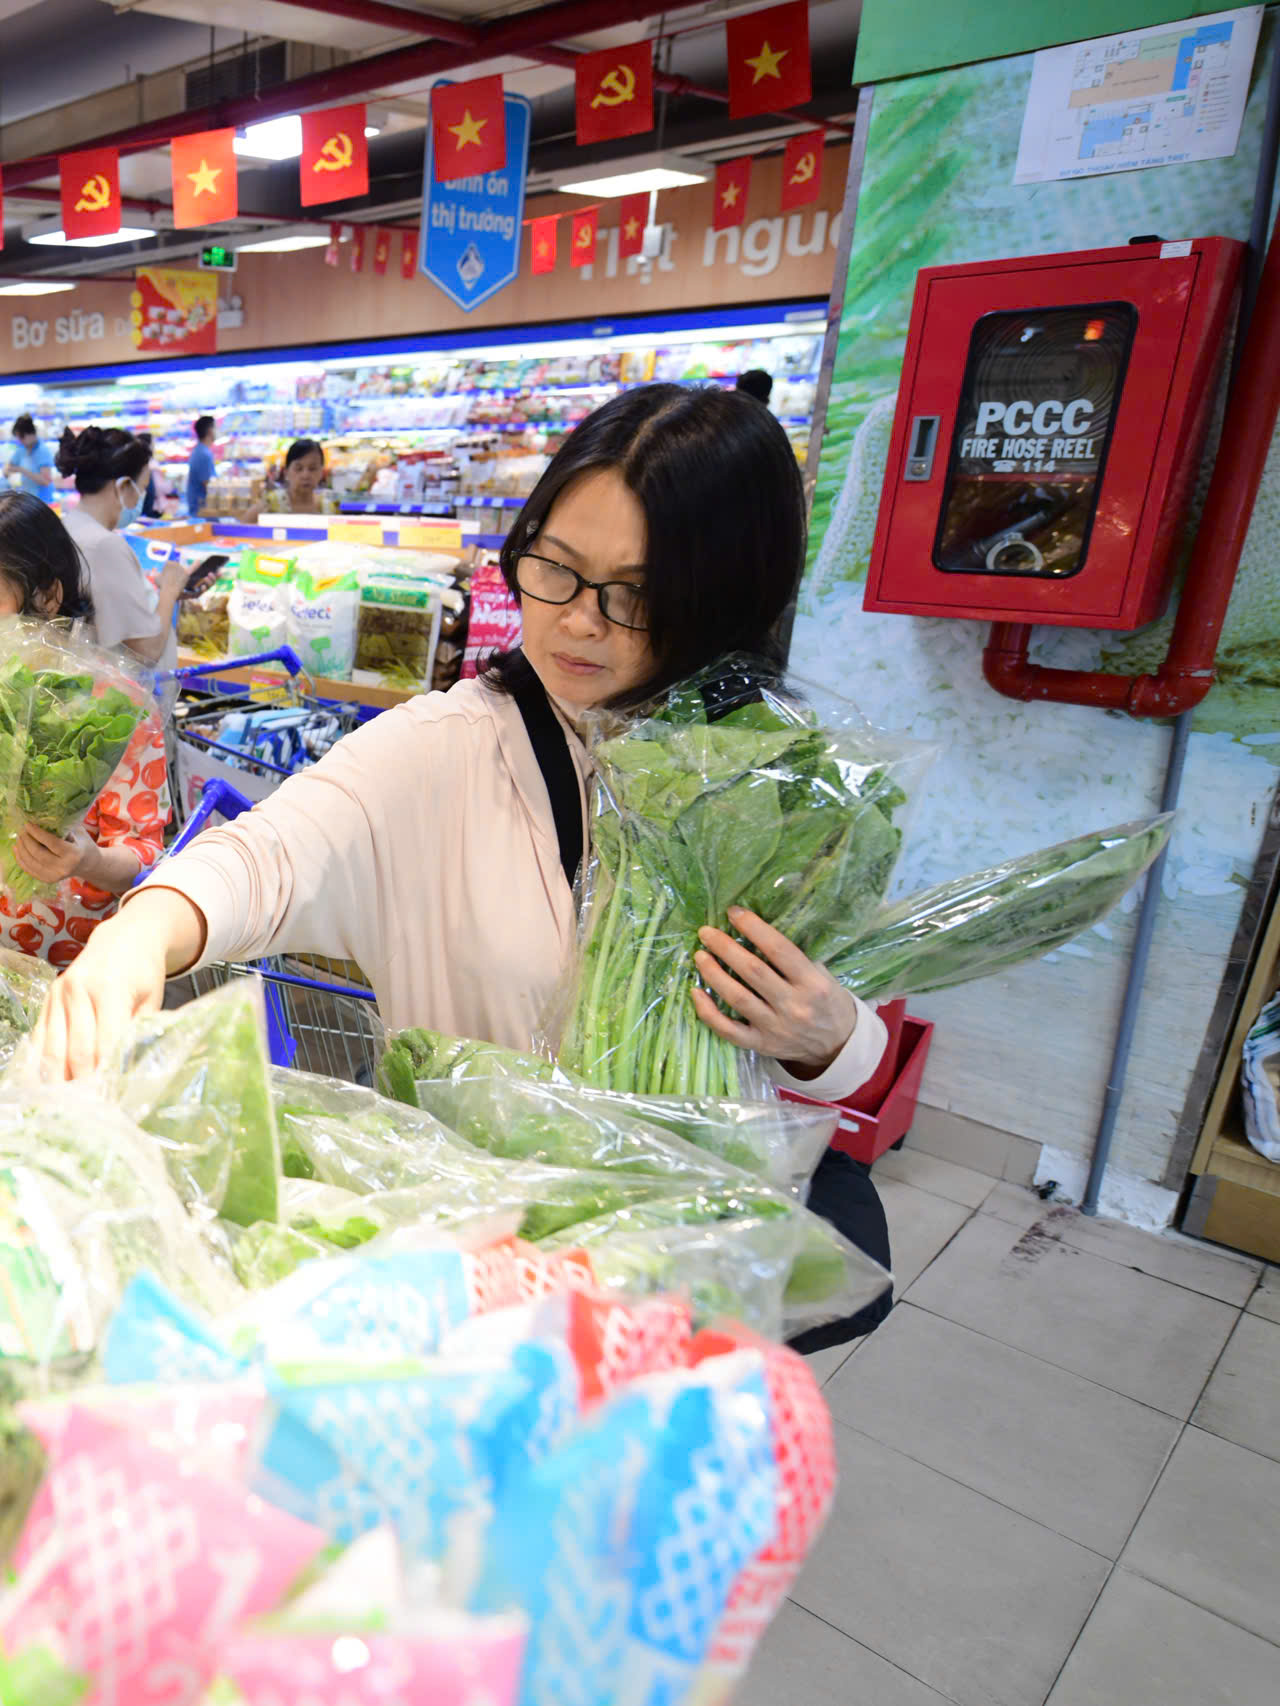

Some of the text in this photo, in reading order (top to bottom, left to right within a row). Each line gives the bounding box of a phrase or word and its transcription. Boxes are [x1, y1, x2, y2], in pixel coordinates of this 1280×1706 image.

[431, 202, 516, 241] thị trường
[11, 315, 48, 349] Bơ
[55, 308, 105, 344] sữa
[974, 398, 1095, 436] PCCC
[960, 438, 1096, 459] FIRE HOSE REEL
[1022, 460, 1057, 473] 114
